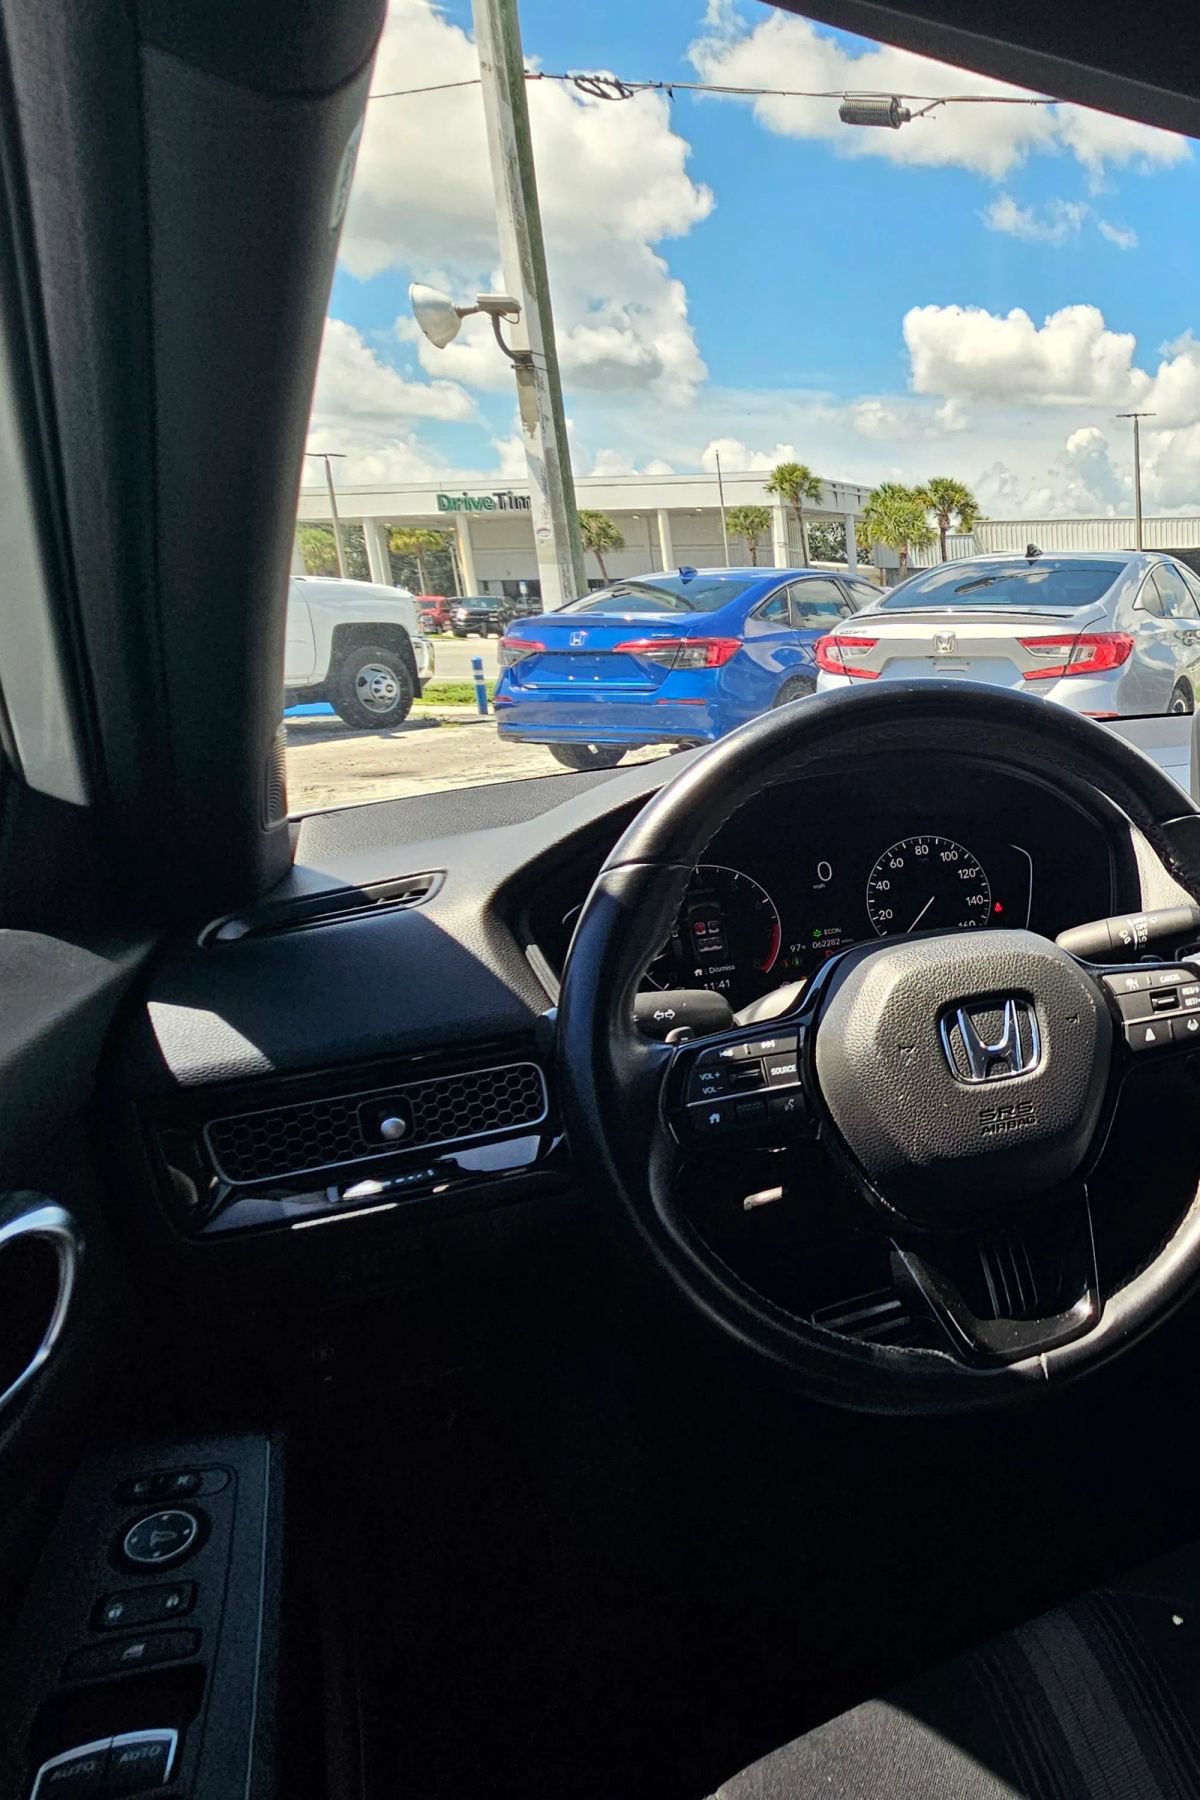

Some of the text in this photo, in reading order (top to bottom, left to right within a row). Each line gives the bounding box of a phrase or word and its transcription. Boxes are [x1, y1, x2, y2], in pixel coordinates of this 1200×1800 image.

[914, 844, 929, 856] 80
[939, 850, 959, 862] 100
[889, 857, 904, 869] 60
[817, 861, 832, 881] 0
[957, 867, 976, 880] 120
[875, 879, 890, 891] 40
[965, 894, 984, 906] 140
[878, 908, 893, 920] 20
[823, 927, 842, 936] ECON
[703, 979, 731, 991] 11:41
[770, 1062, 798, 1076] SOURCE
[980, 1100, 1035, 1125] SRS
[982, 1115, 1037, 1136] AIRBAG
[119, 1745, 162, 1764] AUTO
